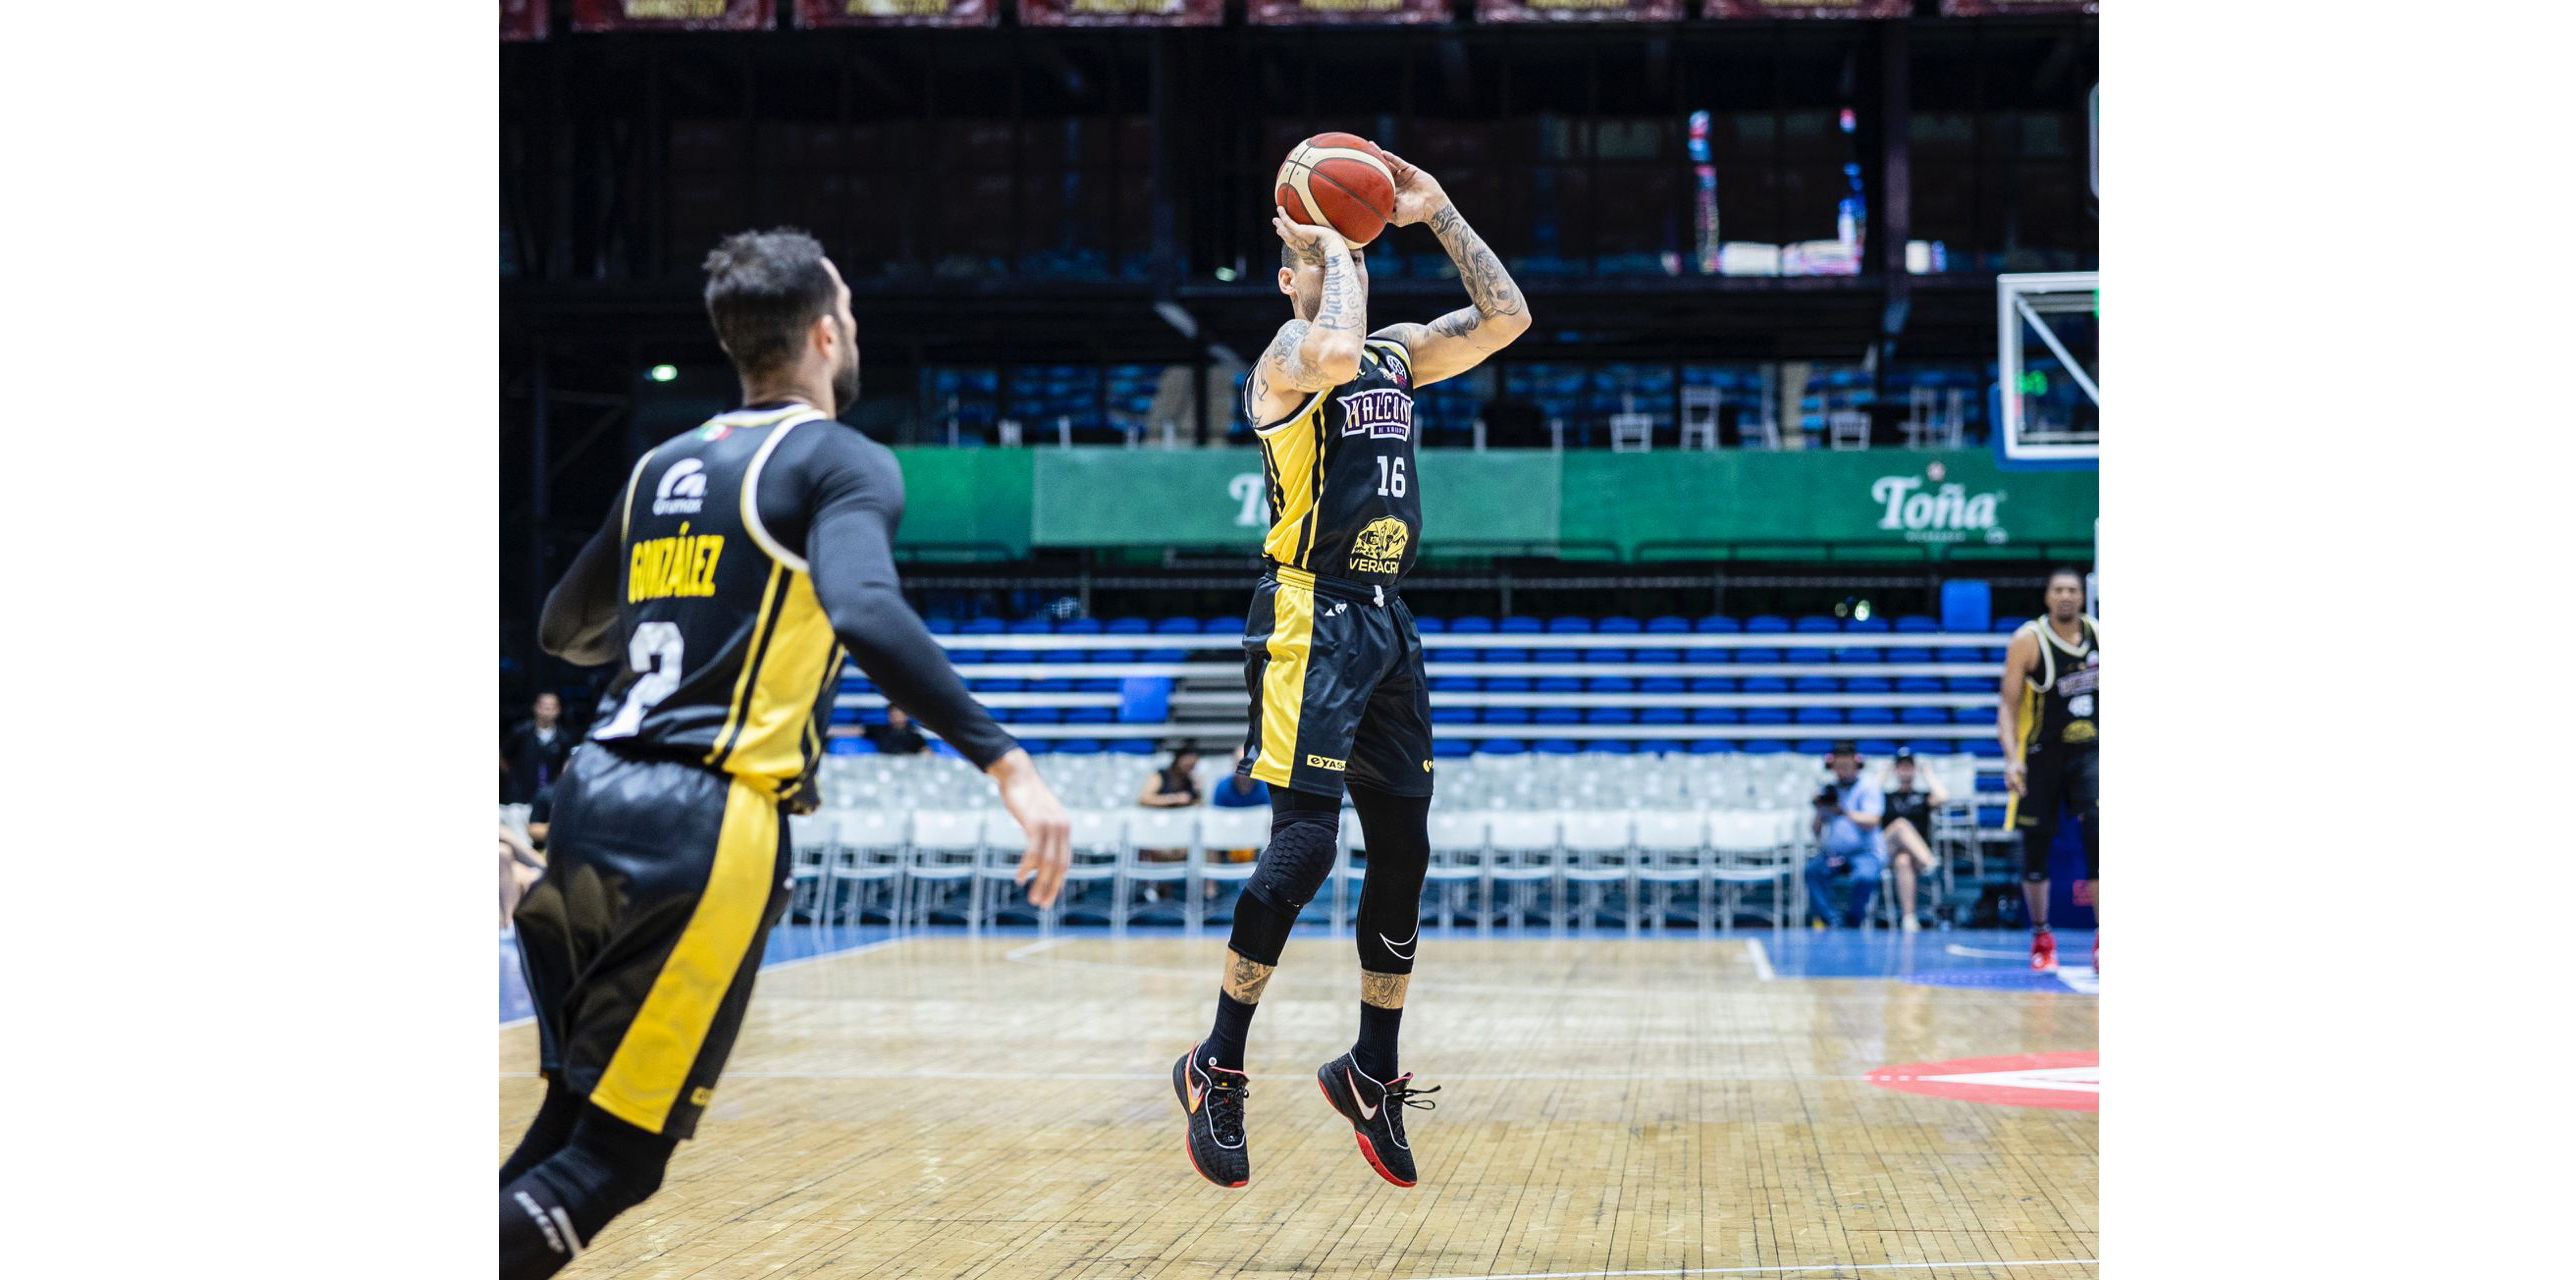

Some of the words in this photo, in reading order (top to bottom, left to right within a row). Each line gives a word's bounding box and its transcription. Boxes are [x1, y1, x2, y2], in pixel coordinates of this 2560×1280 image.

[1376, 455, 1406, 498] 16
[1871, 475, 1998, 530] Toña
[628, 520, 725, 605] GONZÁLEZ
[593, 621, 685, 741] 2
